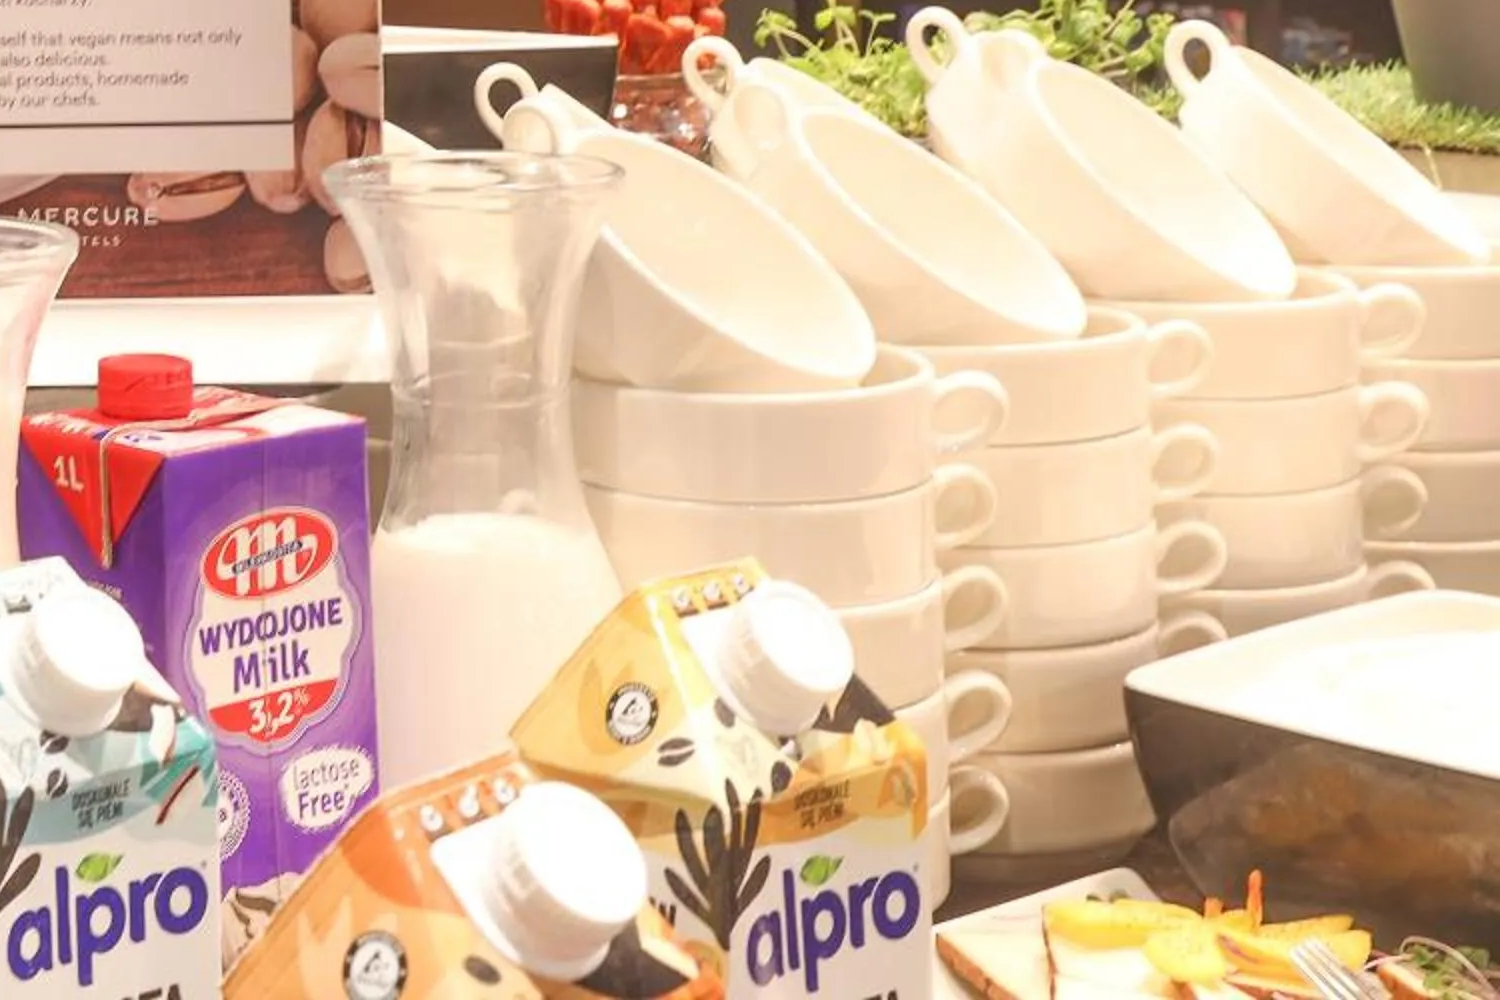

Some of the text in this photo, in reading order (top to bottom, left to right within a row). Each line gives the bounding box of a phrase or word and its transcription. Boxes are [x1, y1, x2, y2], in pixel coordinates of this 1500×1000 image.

[31, 31, 64, 47] that
[69, 33, 116, 49] vegan
[120, 32, 173, 46] means
[176, 30, 204, 45] not
[208, 28, 243, 46] only
[1, 52, 31, 68] also
[16, 72, 93, 92] products,
[97, 70, 190, 86] homemade
[19, 97, 49, 108] our
[16, 205, 160, 228] MERCURE
[81, 235, 122, 248] TELS
[53, 454, 85, 492] 1L
[199, 597, 343, 655] WYDOJONE
[234, 640, 311, 694] Milk
[294, 757, 360, 790] lactose
[7, 865, 209, 987] alpro
[747, 868, 921, 993] alpro
